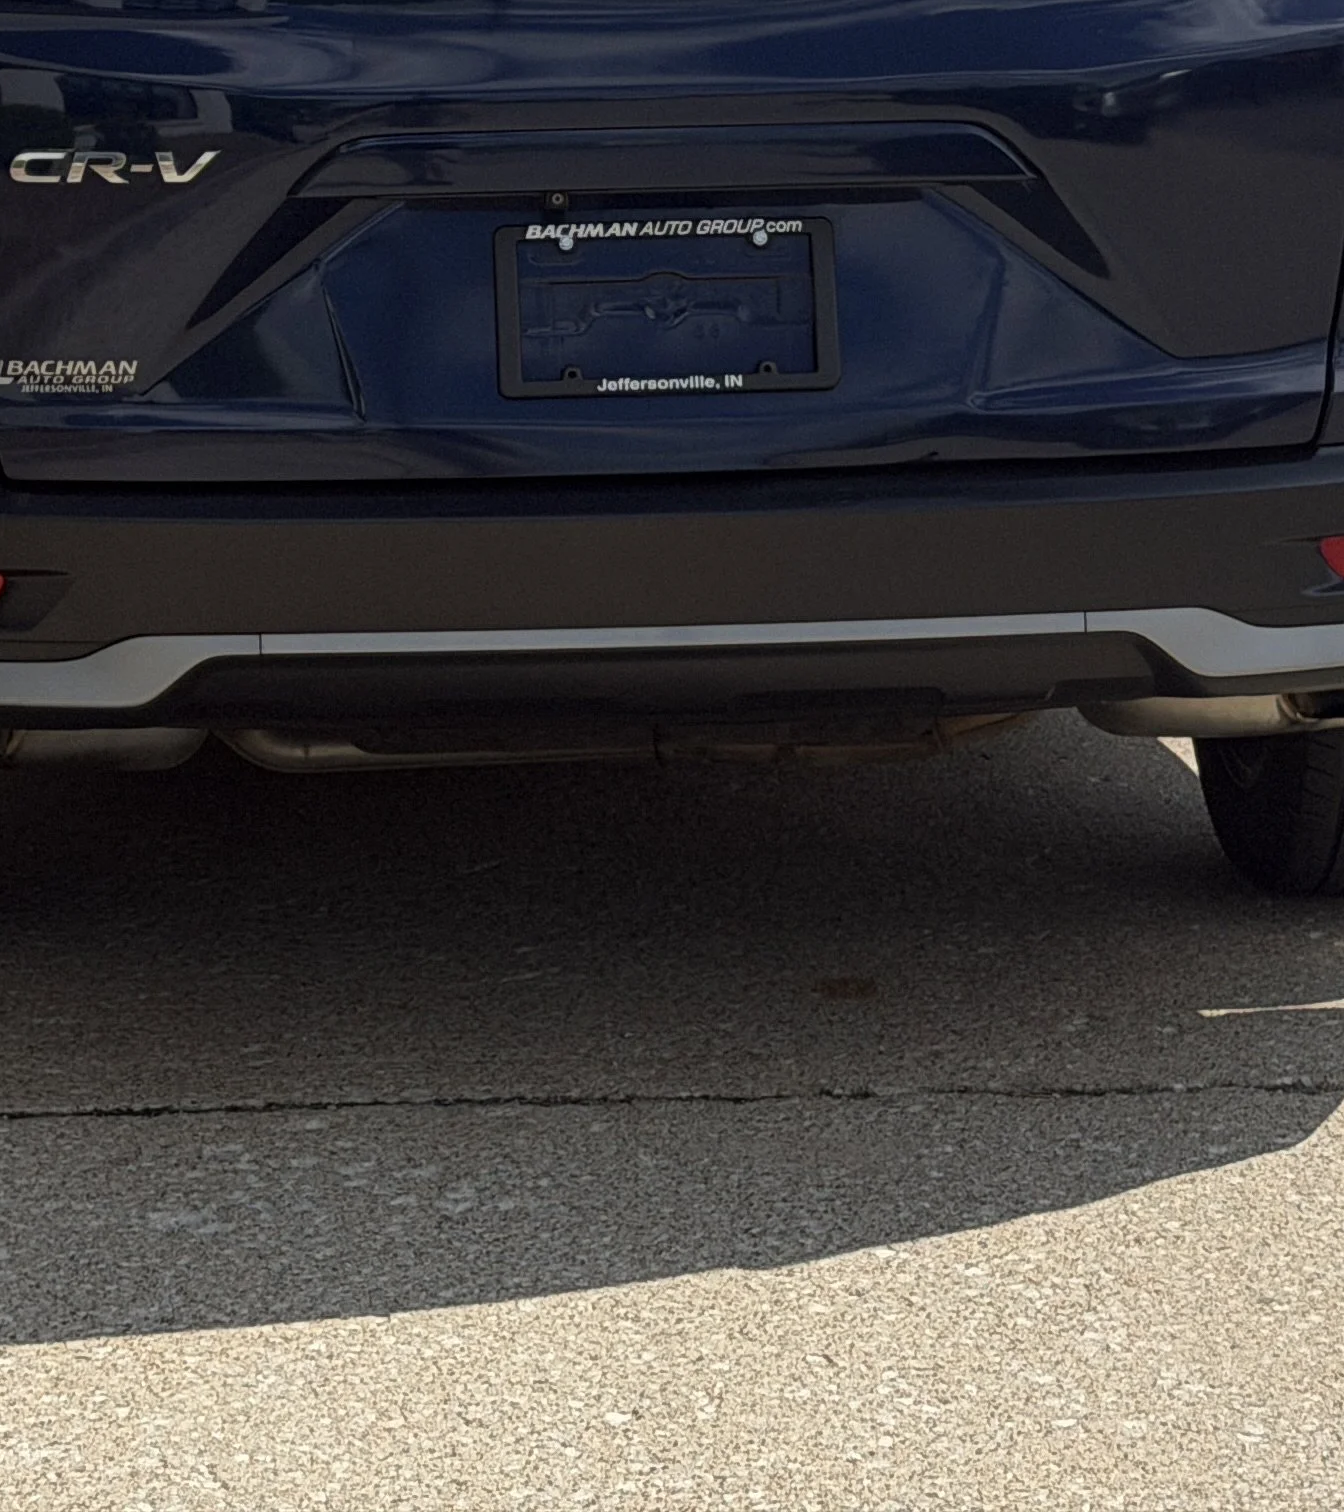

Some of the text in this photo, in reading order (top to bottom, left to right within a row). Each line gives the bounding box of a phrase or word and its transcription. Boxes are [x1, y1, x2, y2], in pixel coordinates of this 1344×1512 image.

[9, 150, 222, 184] CR-V
[525, 222, 638, 239] BACHMAN
[639, 220, 692, 236] AUTO
[7, 360, 138, 376] BACHMAN
[16, 375, 135, 384] AUTO GROUP
[597, 373, 743, 392] Jeffersonville, IN
[102, 384, 113, 393] IN
